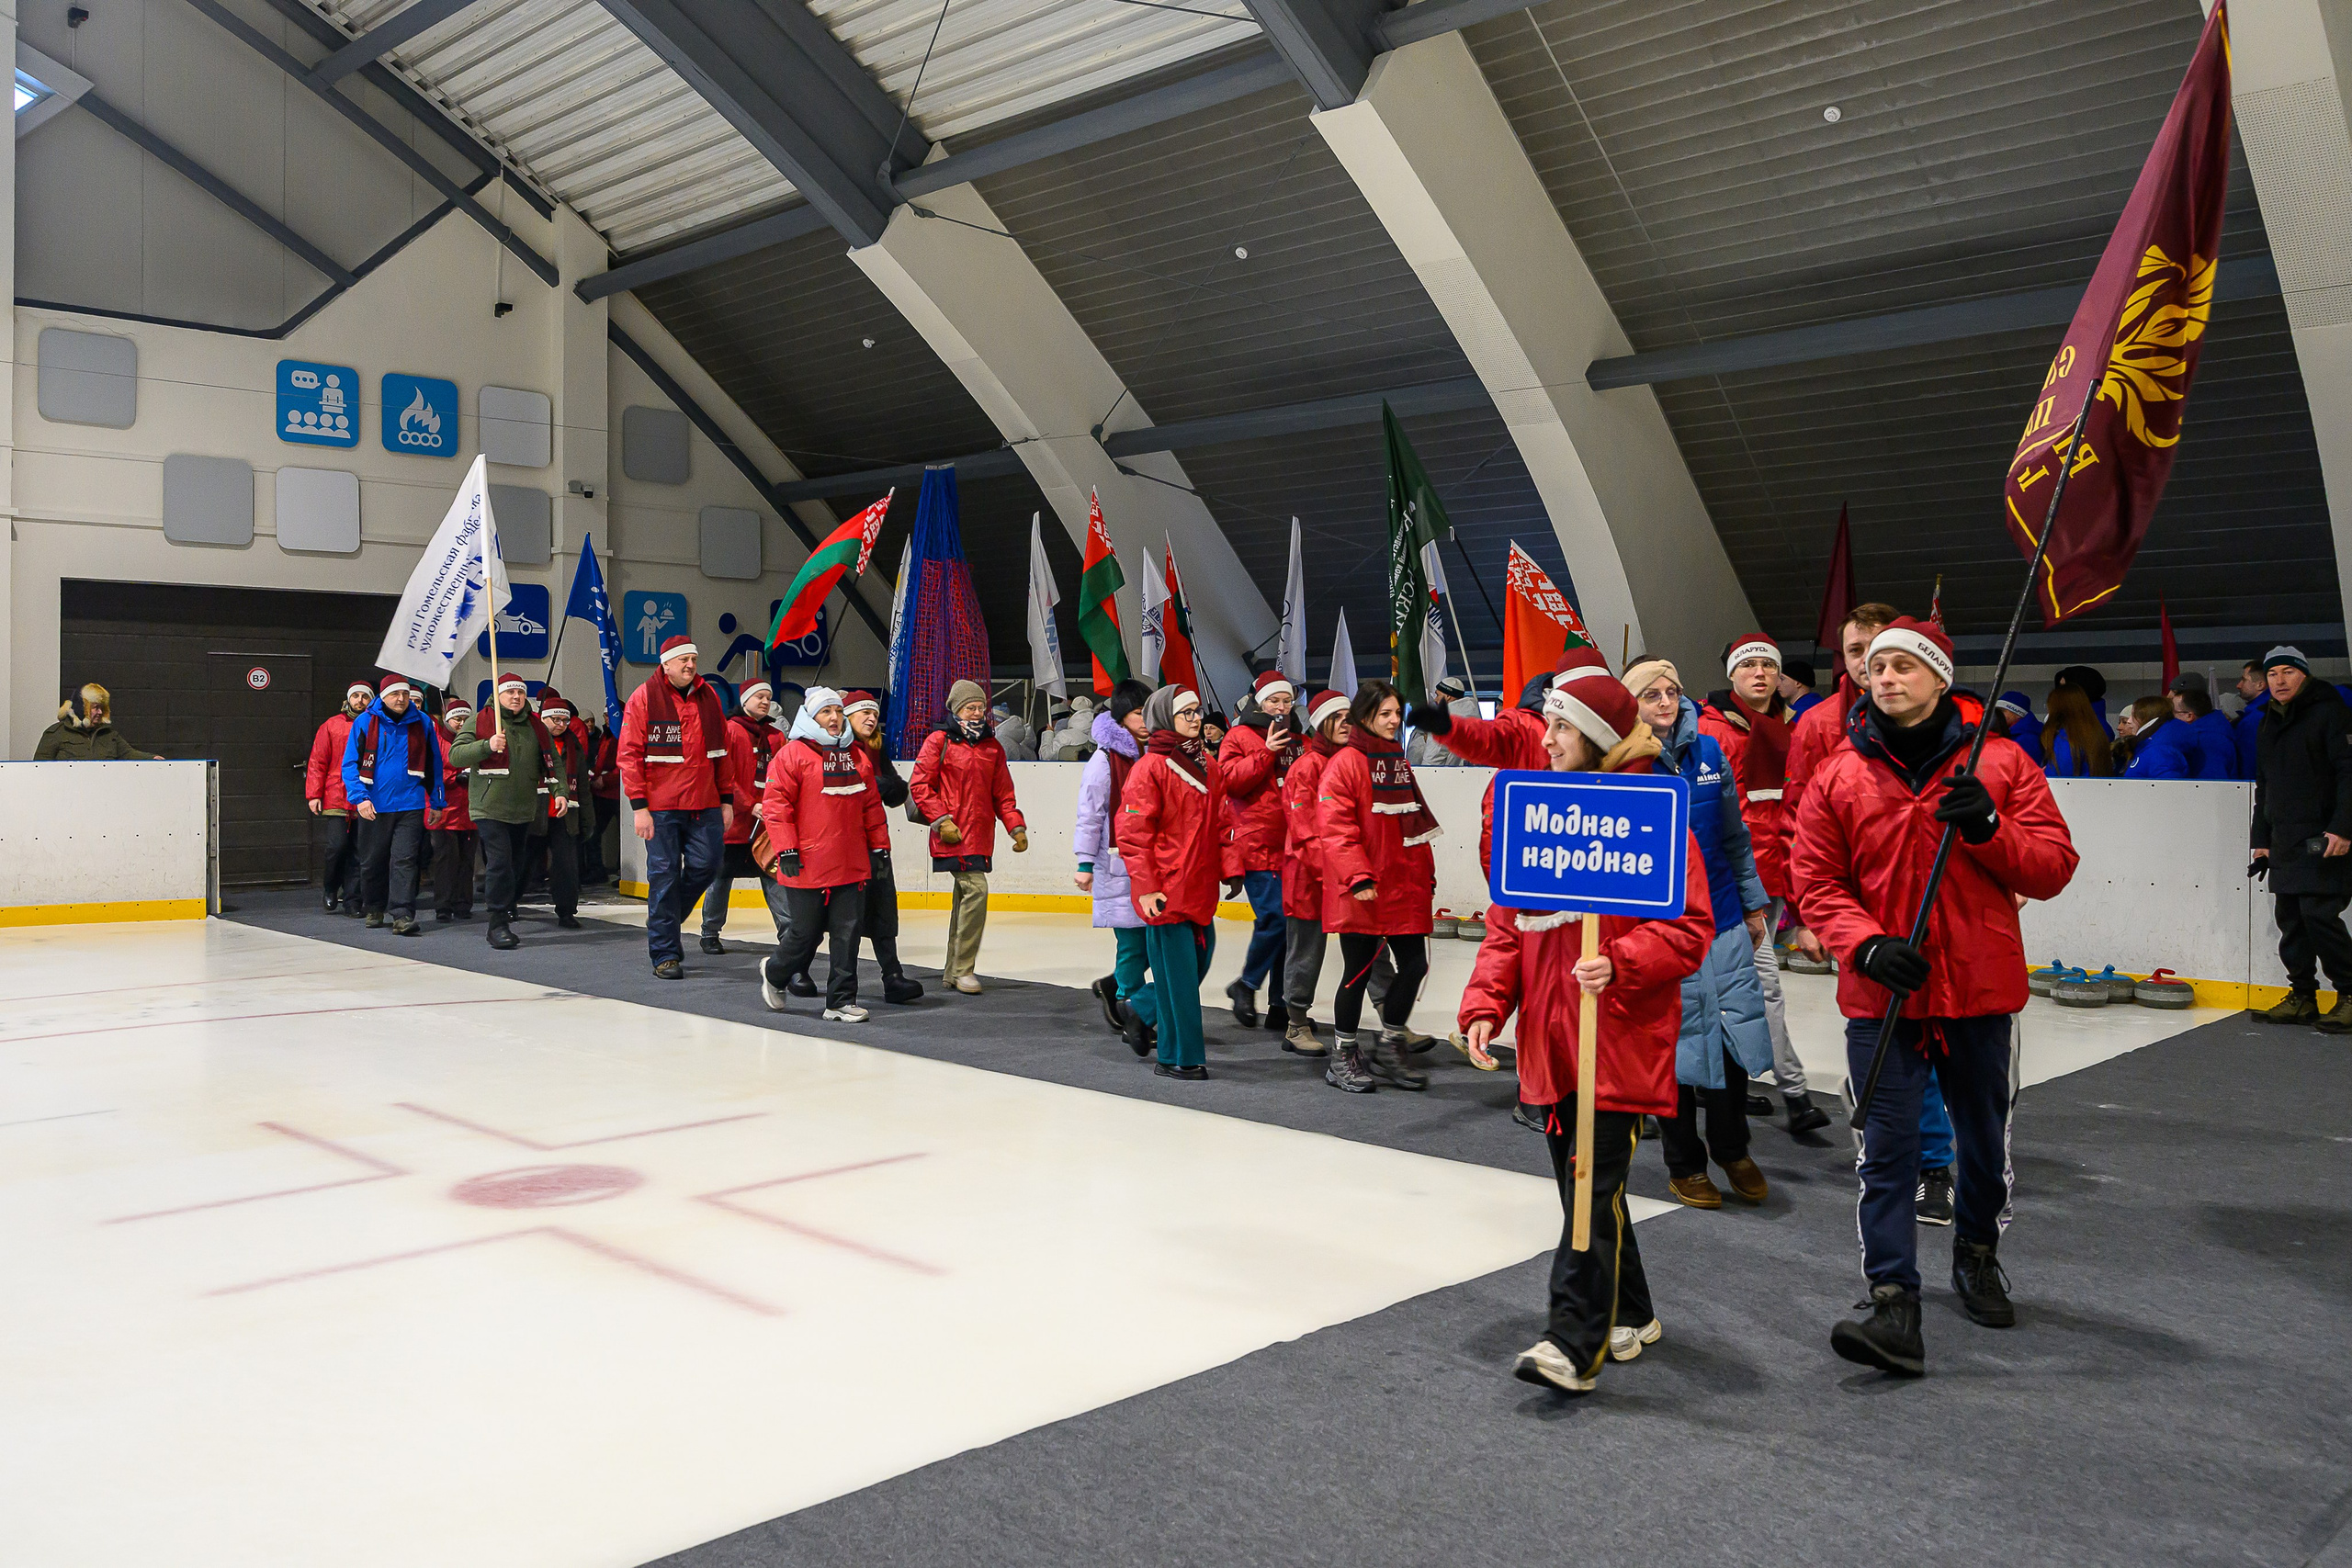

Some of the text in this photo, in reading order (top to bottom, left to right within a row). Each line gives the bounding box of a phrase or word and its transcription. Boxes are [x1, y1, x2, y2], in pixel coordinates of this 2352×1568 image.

[415, 547, 459, 619] Гомельская
[1917, 642, 1953, 677] БЕЛАРУС
[1524, 803, 1631, 839] Моднае
[1522, 840, 1654, 879] народнае
